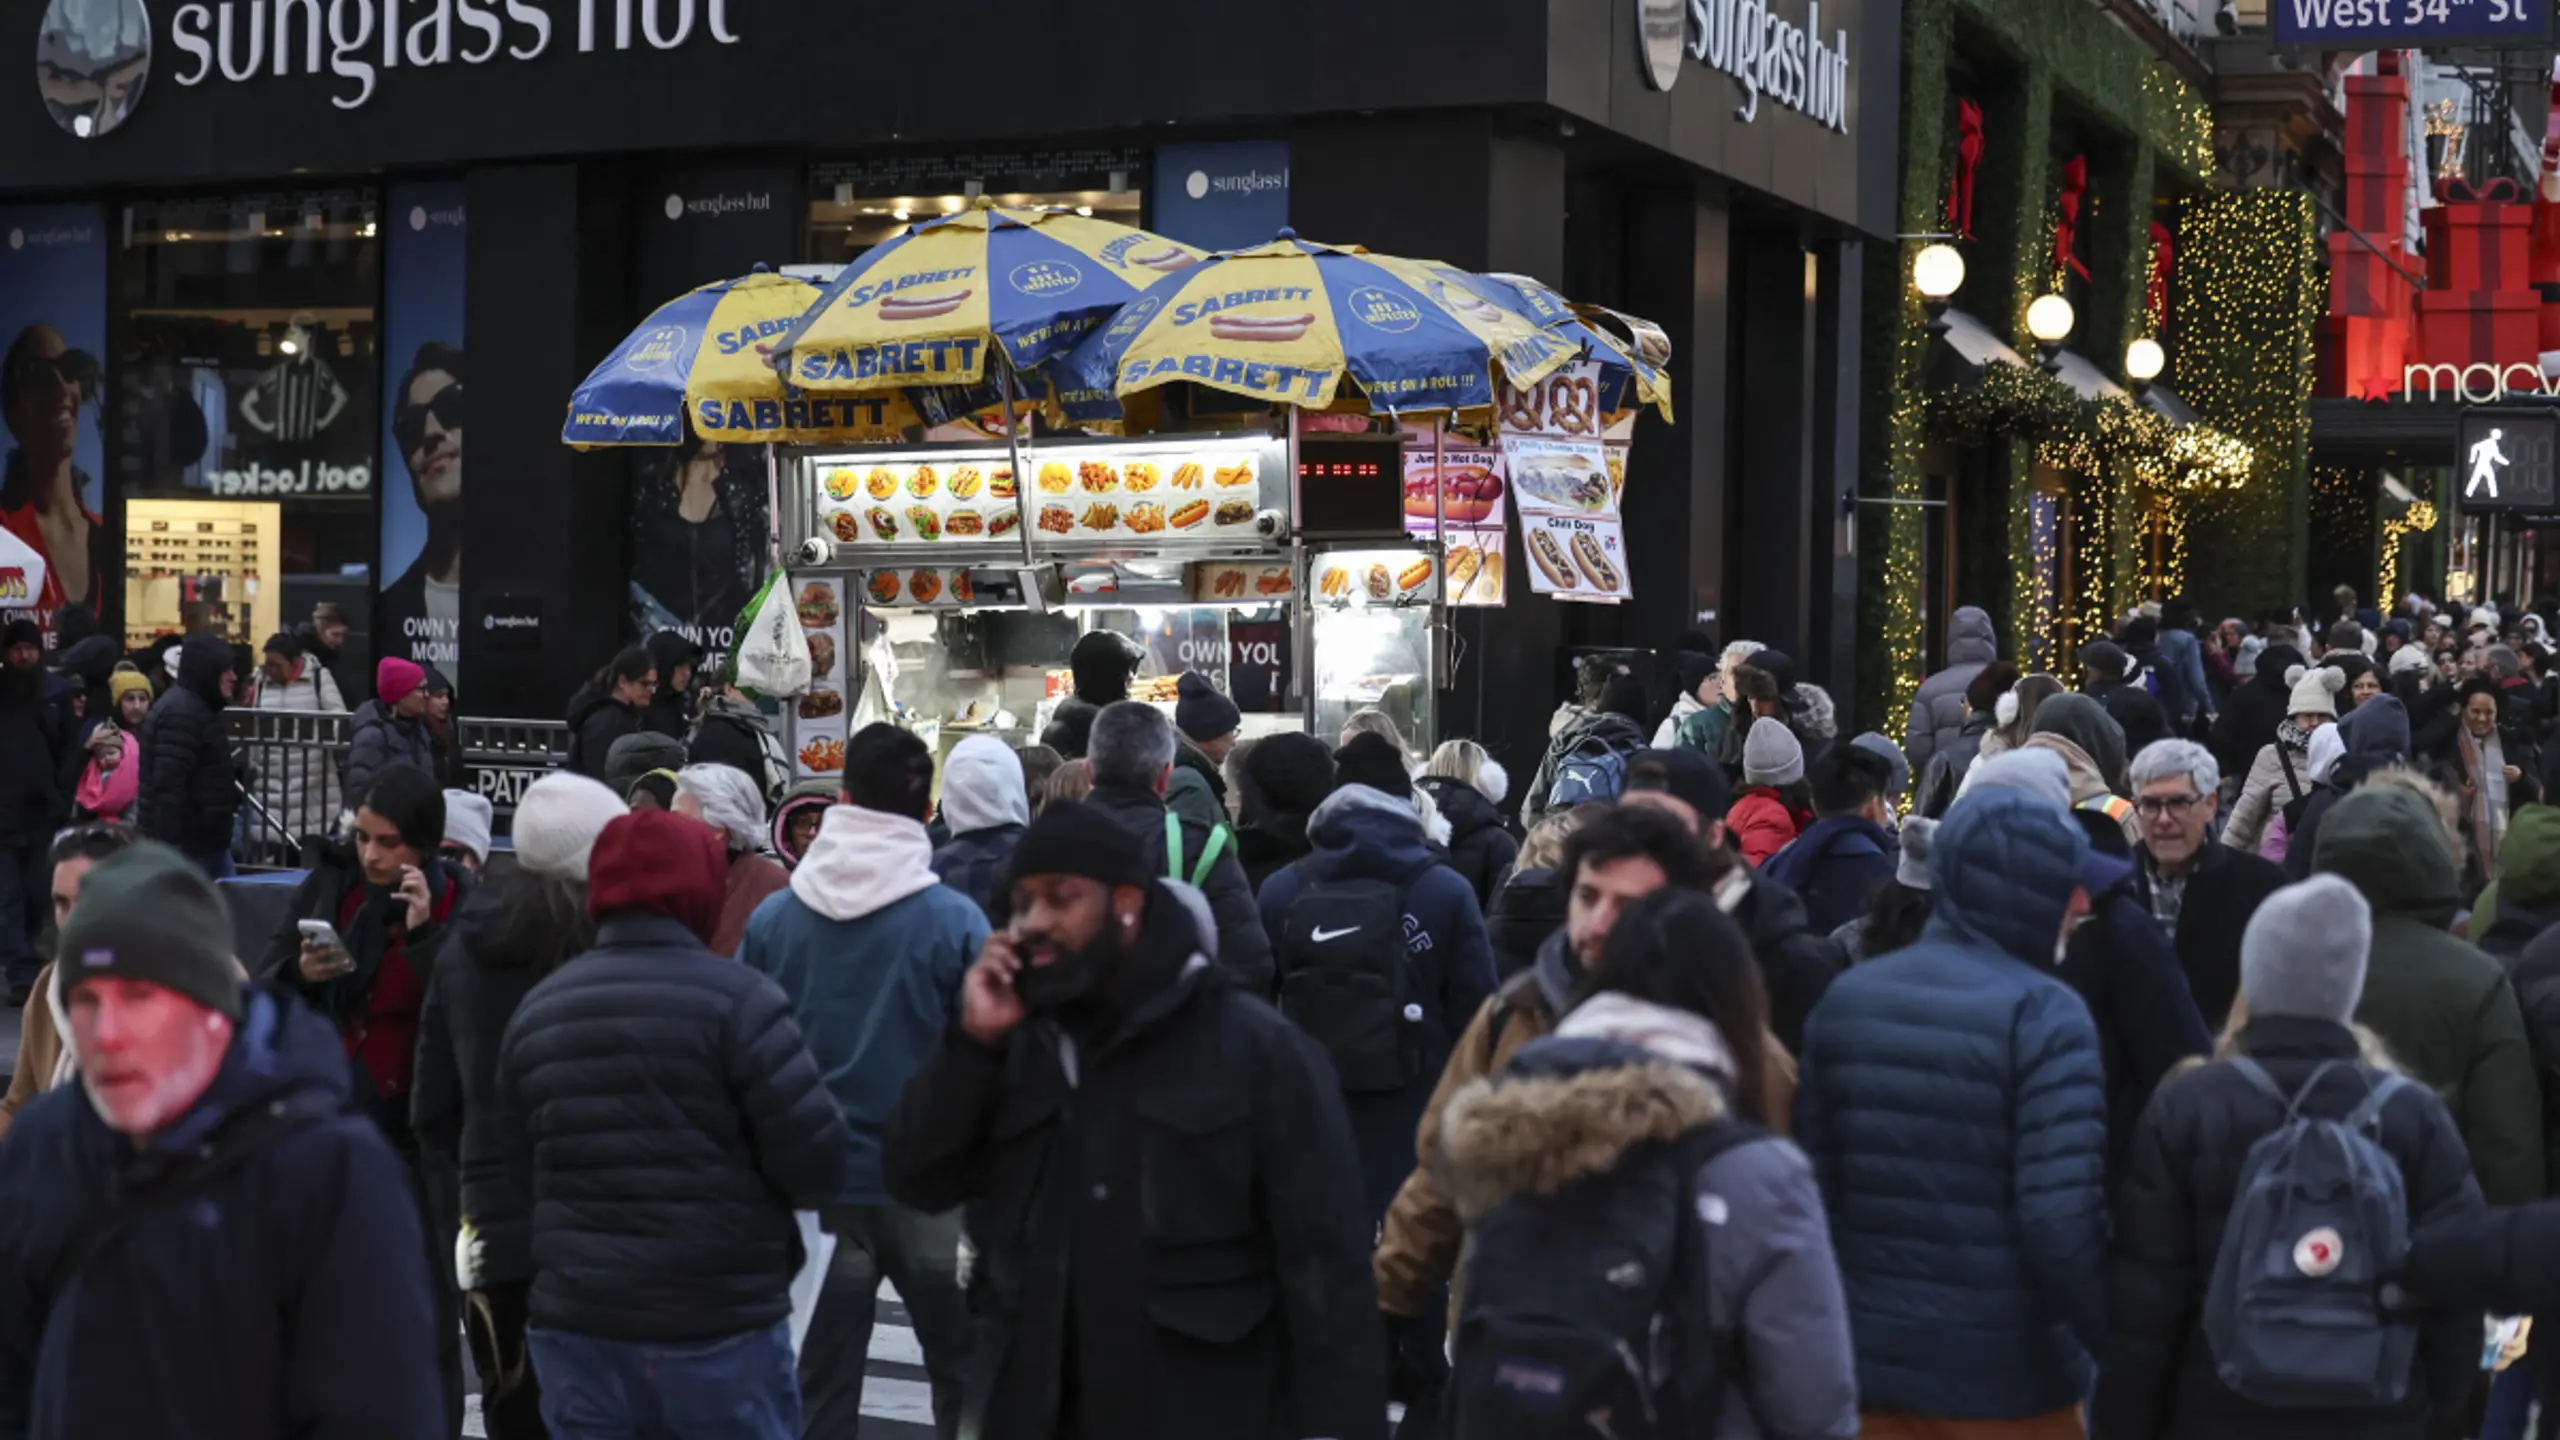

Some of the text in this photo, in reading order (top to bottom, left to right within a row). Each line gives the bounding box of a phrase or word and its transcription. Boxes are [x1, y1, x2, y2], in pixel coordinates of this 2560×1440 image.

[2293, 0, 2391, 29] West
[2488, 0, 2528, 22] St
[172, 0, 552, 109] sunglass
[1688, 0, 1848, 135] sunglass hut
[1212, 169, 1282, 196] sunglass
[848, 265, 976, 308] SABRETT
[1172, 287, 1314, 326] SABRETT
[716, 316, 802, 355] SABR
[799, 338, 981, 381] SABRETT
[1123, 355, 1333, 399] SABRETT
[698, 397, 890, 432] SABRETT
[1414, 454, 1449, 464] Jumo
[1547, 517, 1596, 533] Chili Dog
[403, 616, 445, 638] OWN
[1178, 640, 1233, 663] OWN
